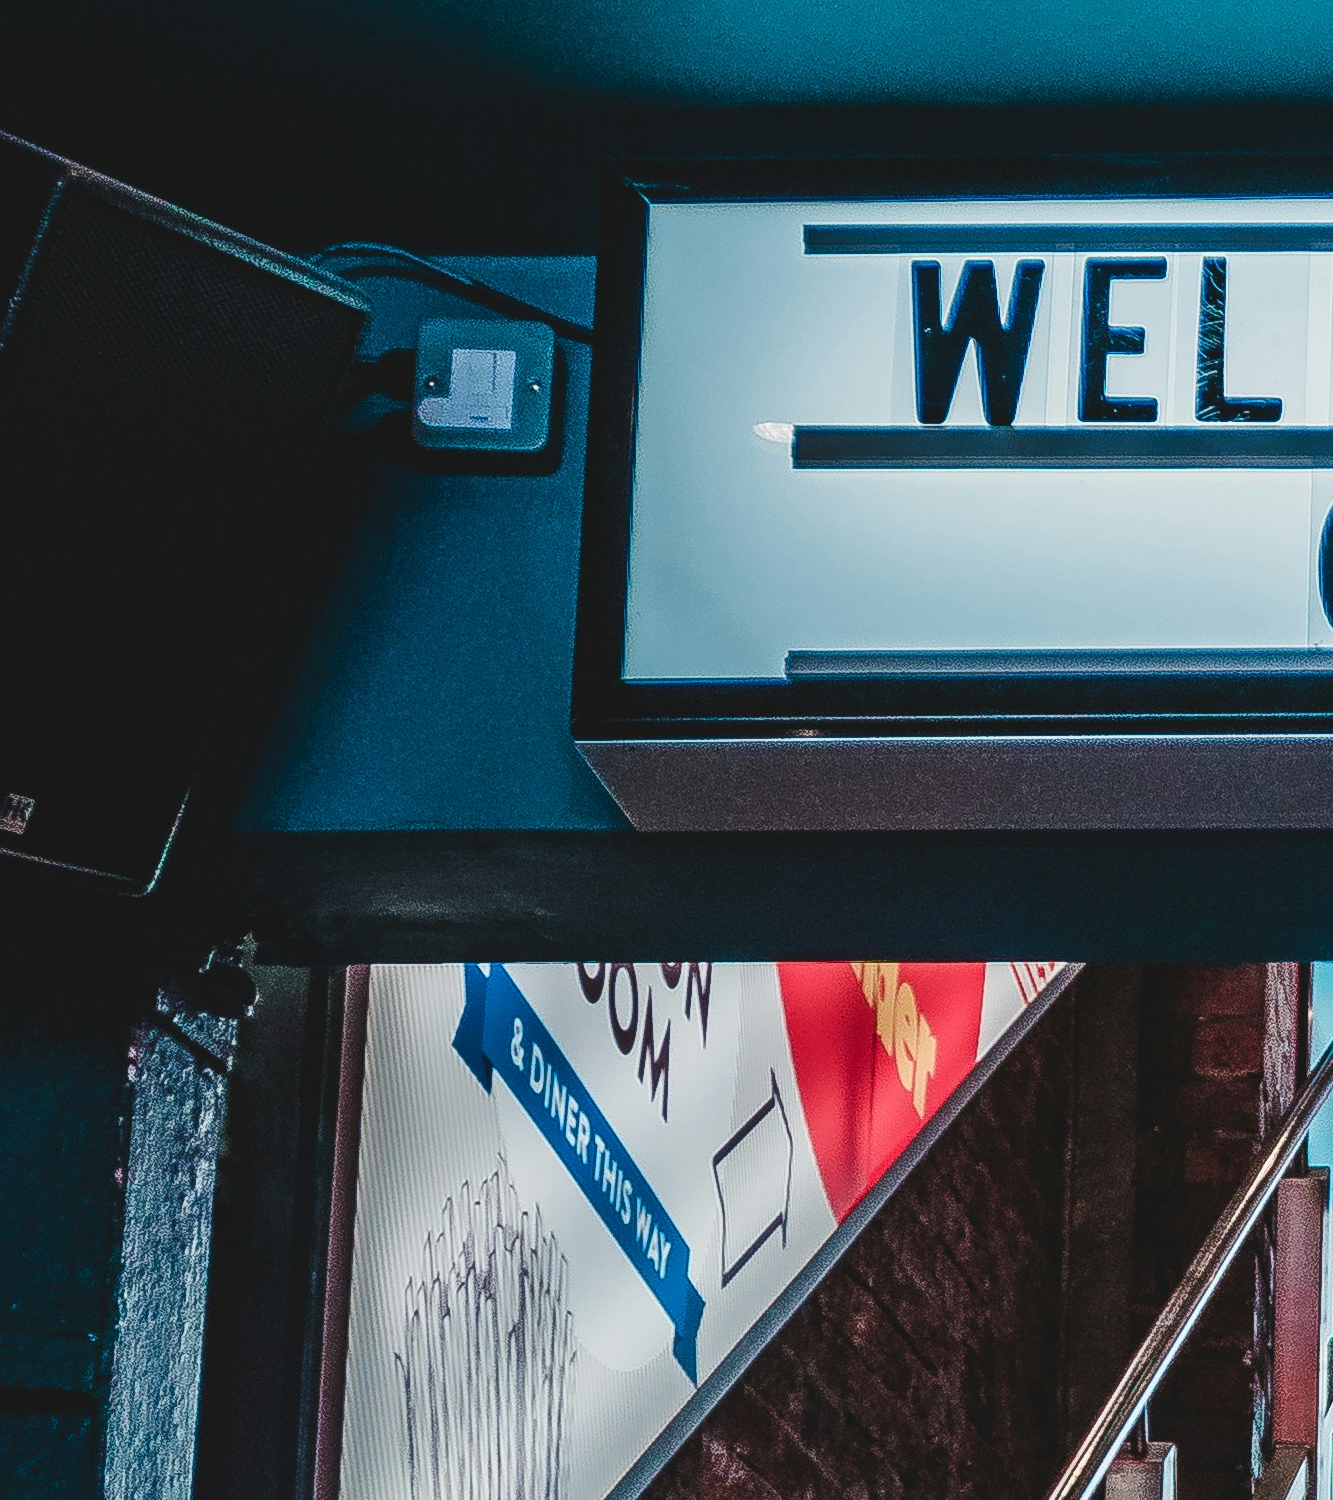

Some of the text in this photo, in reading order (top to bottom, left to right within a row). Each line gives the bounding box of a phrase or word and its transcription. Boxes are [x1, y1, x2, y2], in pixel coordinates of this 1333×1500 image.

[510, 1017, 672, 1280] & DINER THIS WAY
